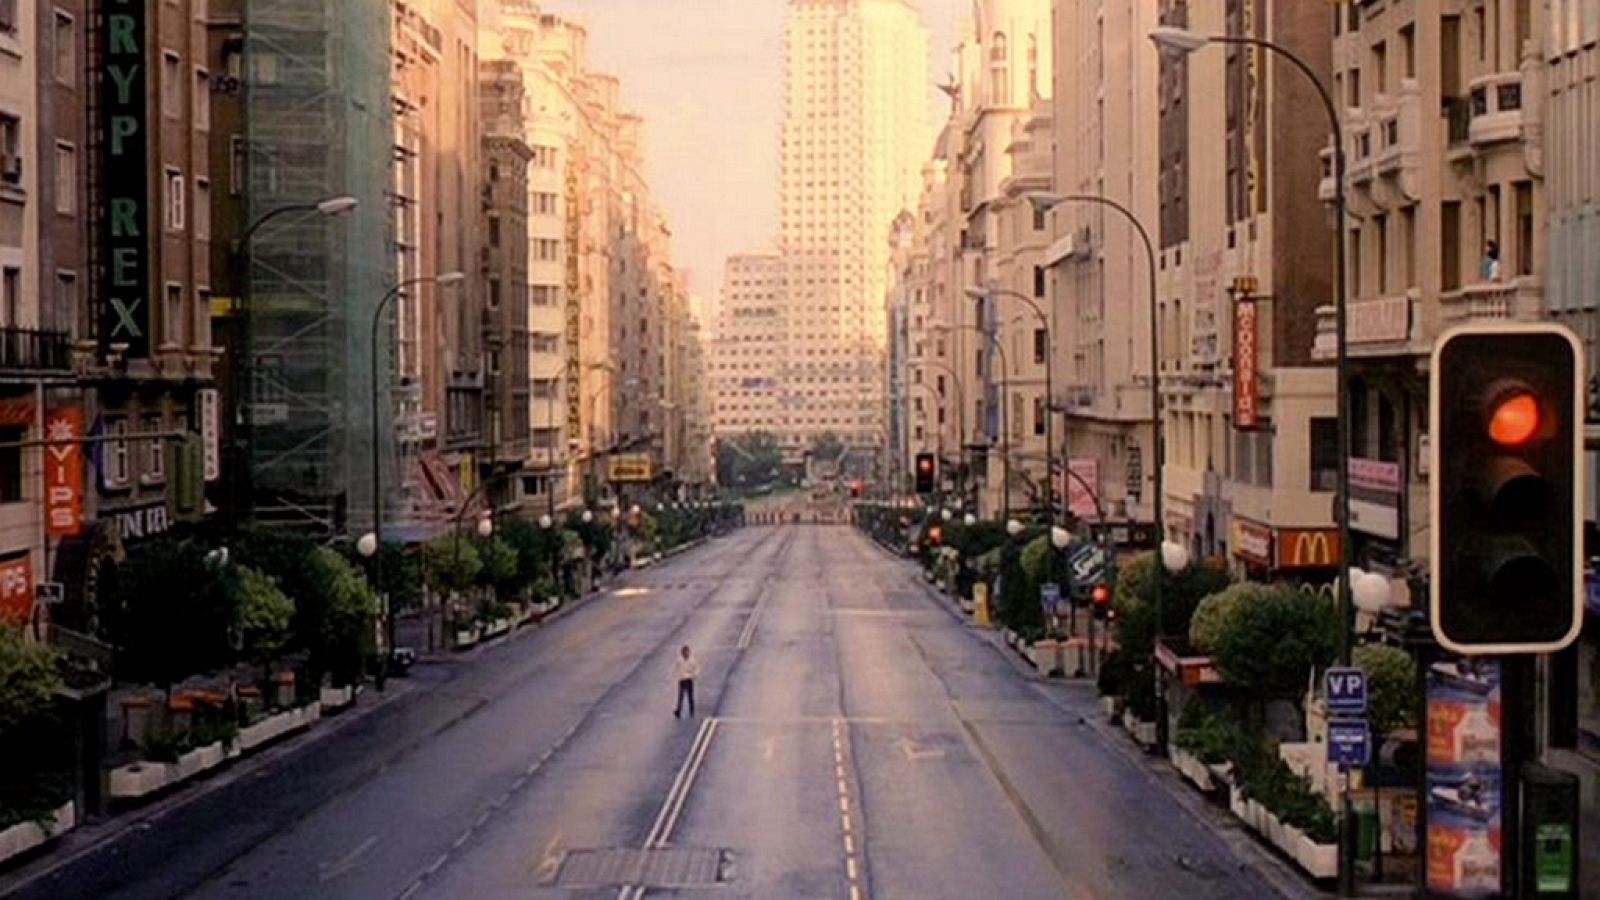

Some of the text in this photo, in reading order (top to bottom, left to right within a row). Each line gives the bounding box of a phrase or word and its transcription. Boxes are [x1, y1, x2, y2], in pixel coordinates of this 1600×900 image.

[107, 0, 142, 337] RYP REX
[49, 444, 74, 527] VIPS
